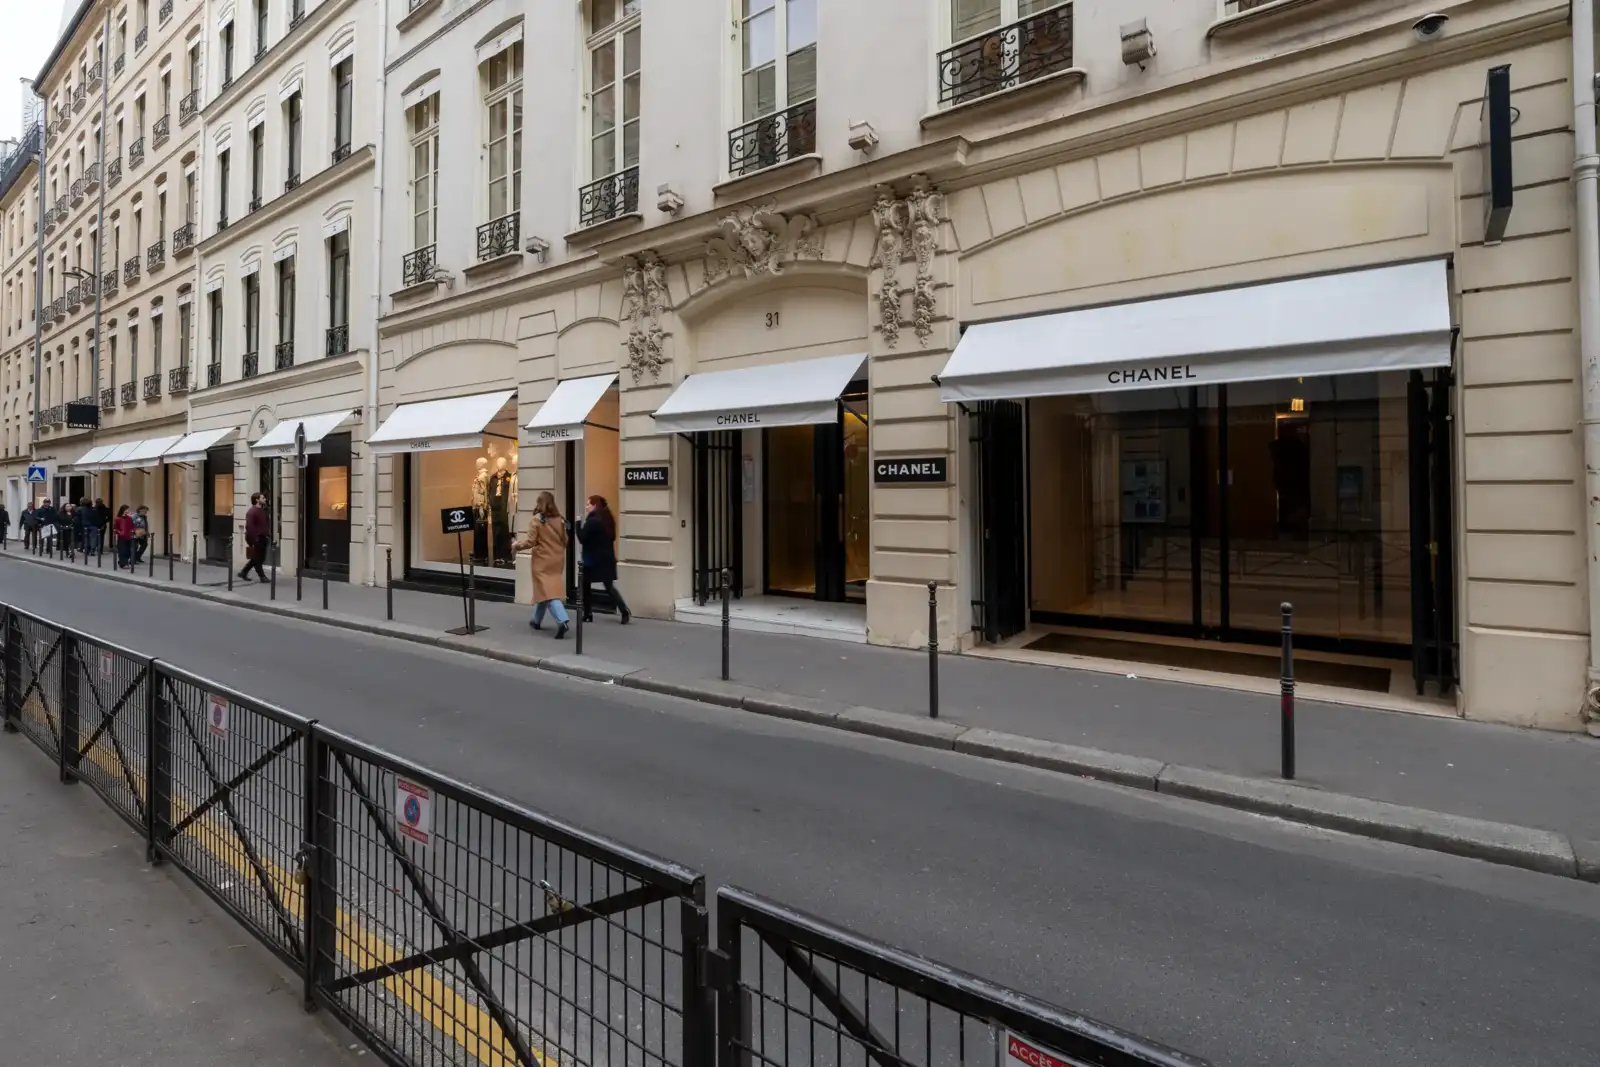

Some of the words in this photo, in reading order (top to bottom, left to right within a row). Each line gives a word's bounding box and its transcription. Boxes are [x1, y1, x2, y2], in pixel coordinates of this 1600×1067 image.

[765, 311, 780, 328] 31
[1107, 364, 1197, 384] CHANEL
[716, 413, 761, 425] CHANEL
[540, 429, 570, 439] CHANEL
[410, 441, 431, 449] CHANEL
[877, 463, 941, 476] CHANEL
[626, 471, 665, 481] CHANEL
